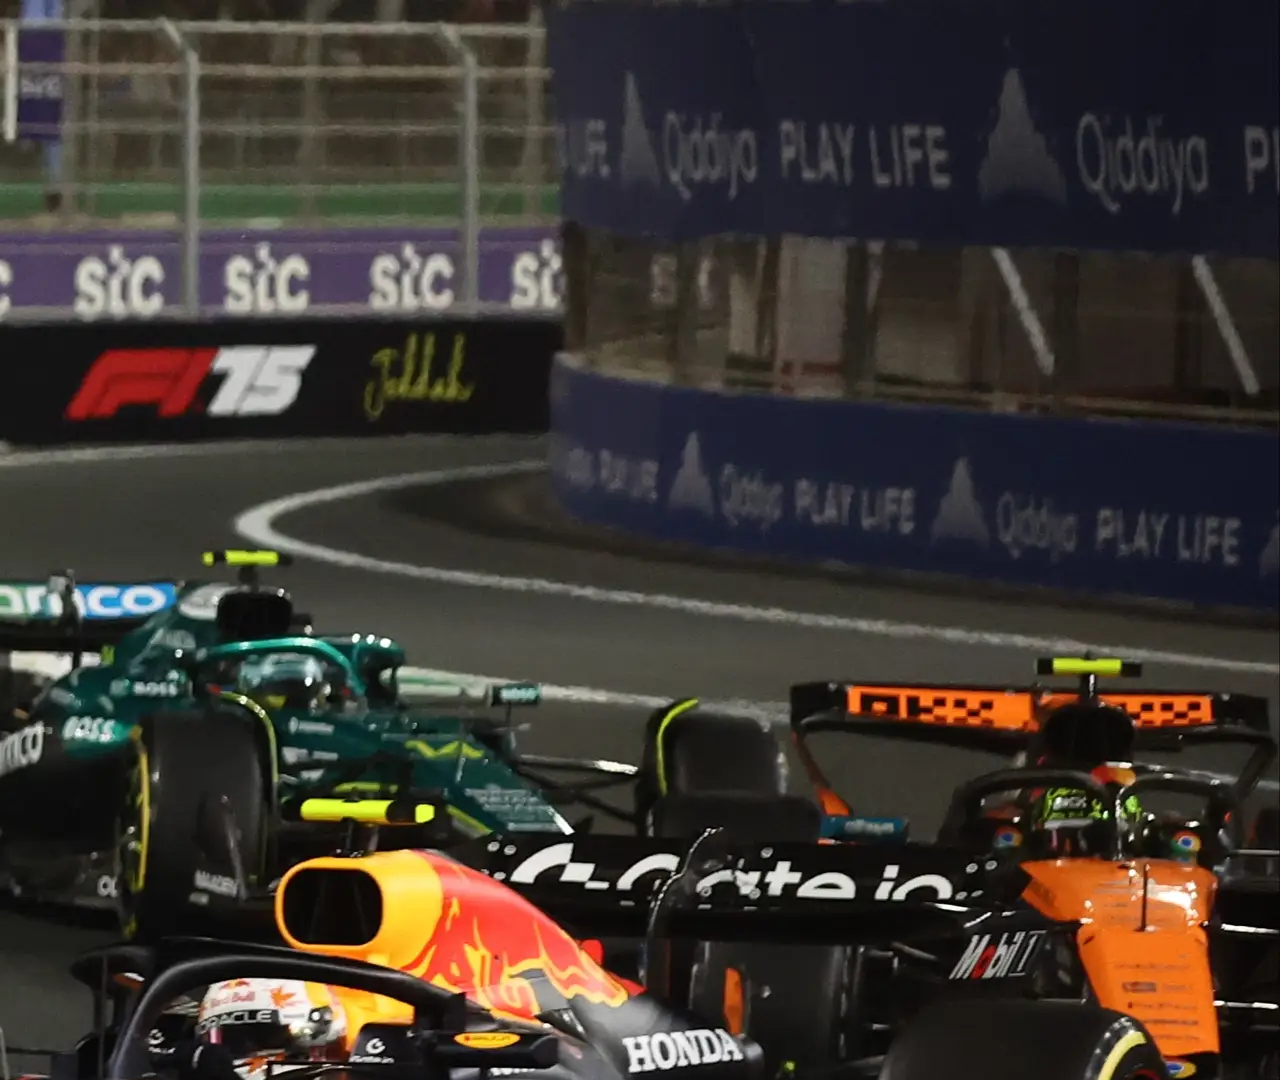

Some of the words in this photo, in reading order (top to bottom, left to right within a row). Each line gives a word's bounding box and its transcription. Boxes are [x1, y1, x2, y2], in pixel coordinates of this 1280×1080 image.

[781, 120, 854, 183] PLAY
[869, 125, 951, 190] LIFE
[1077, 111, 1210, 214] Qiddiya
[74, 243, 165, 319] stc
[223, 241, 310, 316] stc
[369, 240, 454, 311] stc
[510, 238, 565, 310] st
[794, 477, 854, 525] PLAY
[860, 486, 916, 534] LIFE
[1097, 507, 1168, 558] PLAY
[1178, 512, 1240, 566] LIFE
[949, 930, 1024, 980] Mobil
[198, 1009, 273, 1030] ORACLE
[622, 1028, 745, 1074] HONDA
